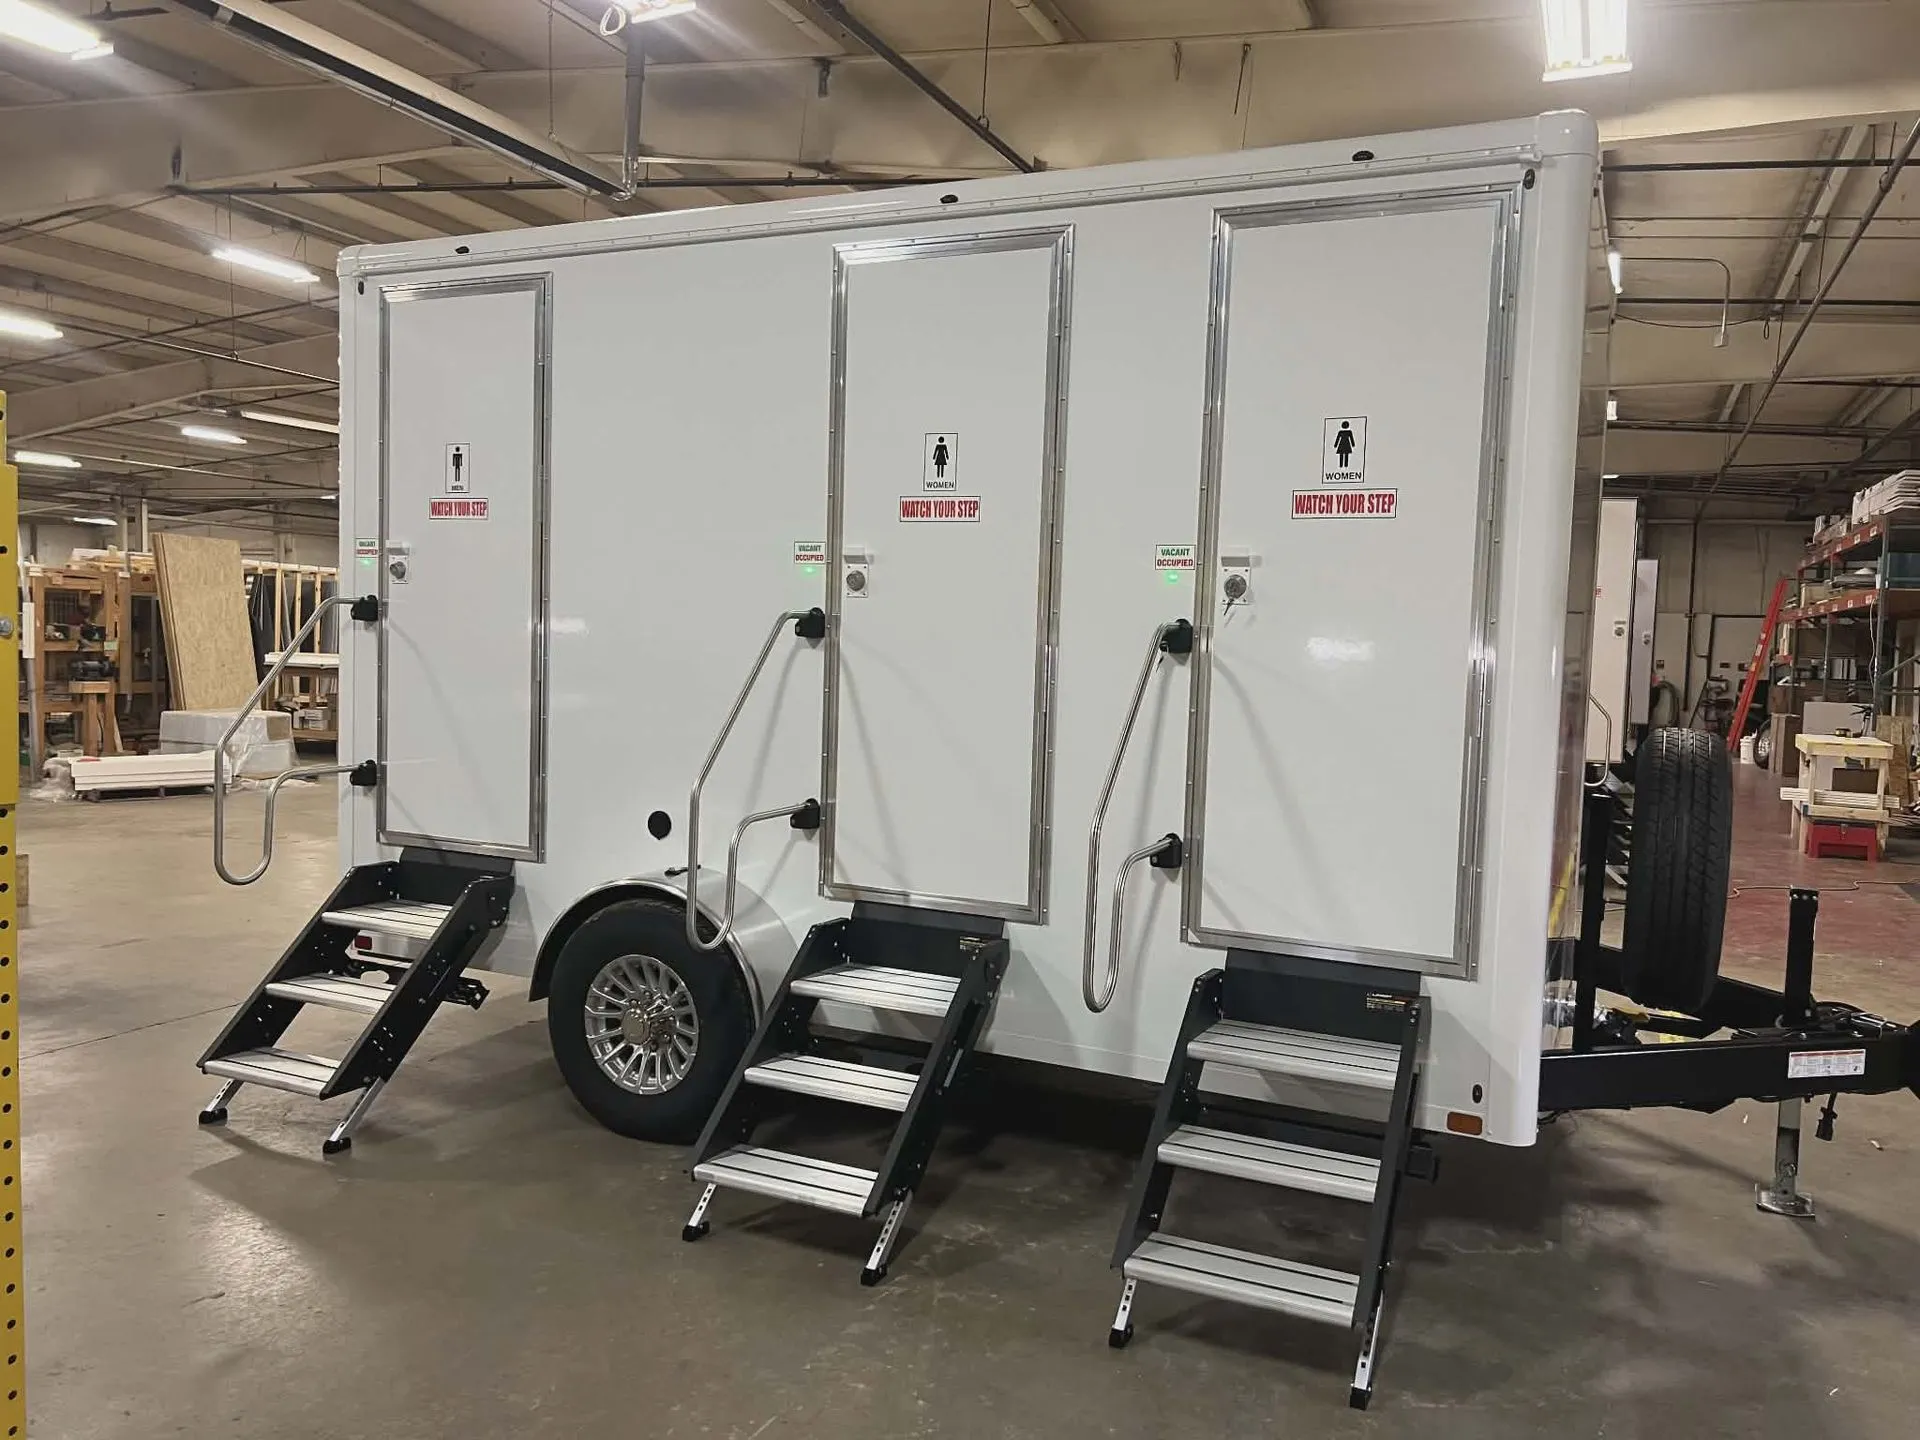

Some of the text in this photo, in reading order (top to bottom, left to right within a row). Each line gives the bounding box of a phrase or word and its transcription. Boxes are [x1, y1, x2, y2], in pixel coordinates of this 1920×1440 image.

[1325, 472, 1362, 481] WOMEN
[925, 481, 955, 489] WOMEN
[1294, 493, 1395, 515] WATCH YOUR STEP
[431, 502, 487, 516] WATCH YOUR STEP
[901, 500, 979, 518] WATCH YOUR STEP
[1160, 548, 1191, 557] VACANT
[795, 554, 824, 562] OCCUPIED
[1156, 559, 1194, 567] OCCUPIED
